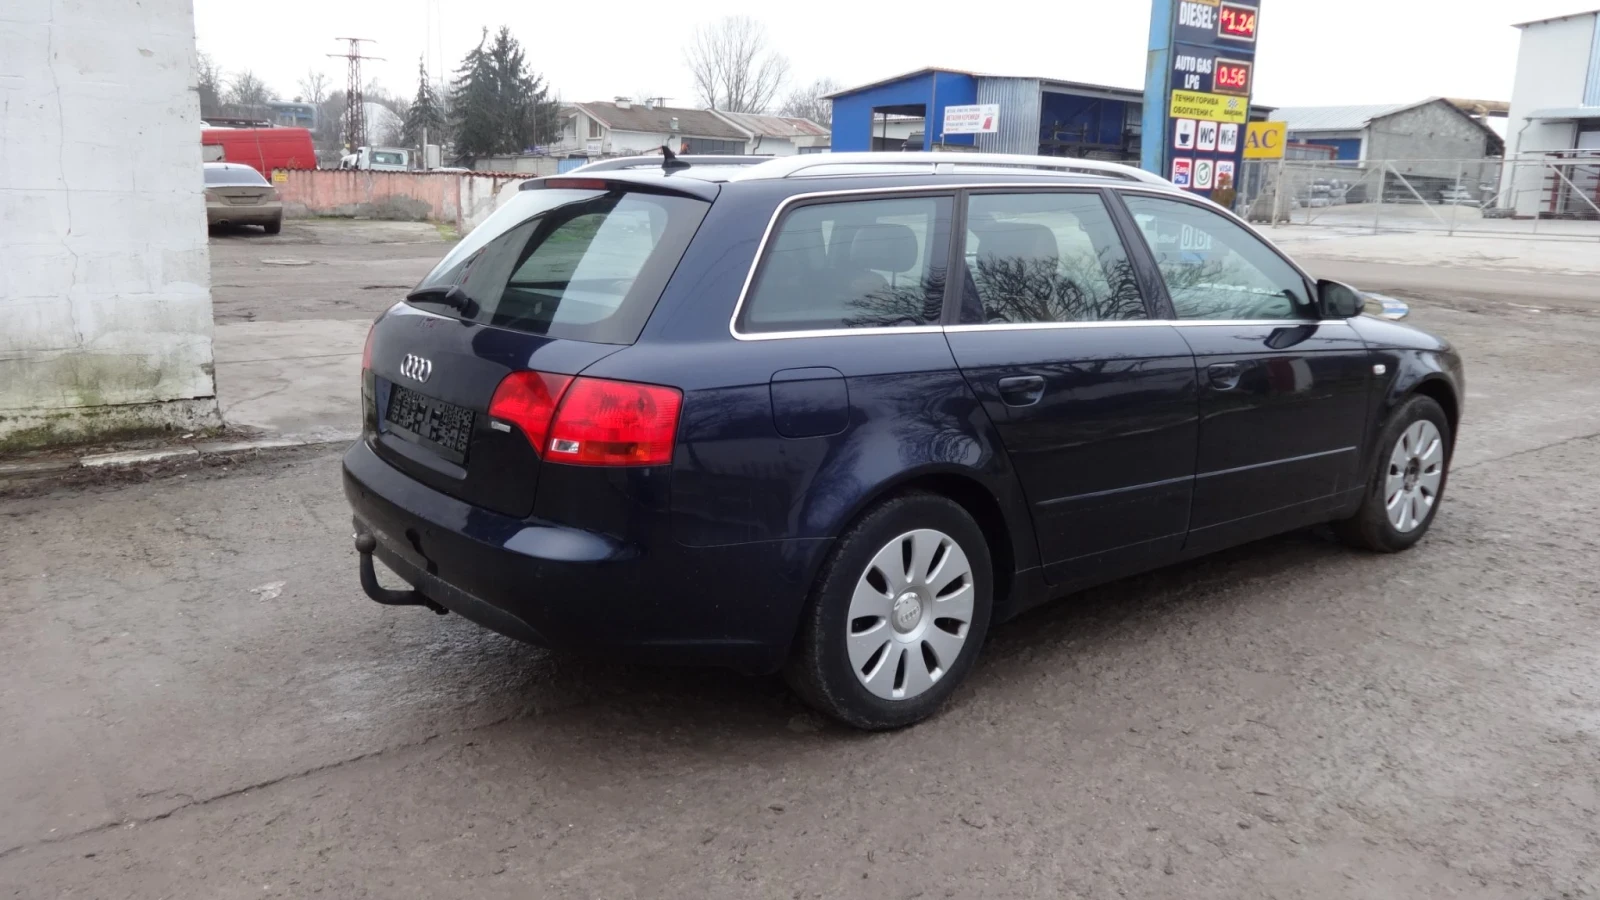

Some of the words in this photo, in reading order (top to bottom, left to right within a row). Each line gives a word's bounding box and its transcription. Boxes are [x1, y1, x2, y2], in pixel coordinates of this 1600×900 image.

[1175, 55, 1195, 71] AUTO
[1196, 58, 1212, 74] GAS
[1219, 66, 1246, 86] 0.56
[1184, 74, 1200, 90] LPG
[1175, 94, 1195, 103] ТЕЧНИ
[1195, 96, 1219, 105] ГОРИВА
[1173, 106, 1208, 117] ОБОГАТЕНИ
[1200, 127, 1214, 144] WC
[1175, 164, 1189, 175] Easy
[1218, 164, 1232, 172] VISA
[1174, 173, 1186, 183] Pay
